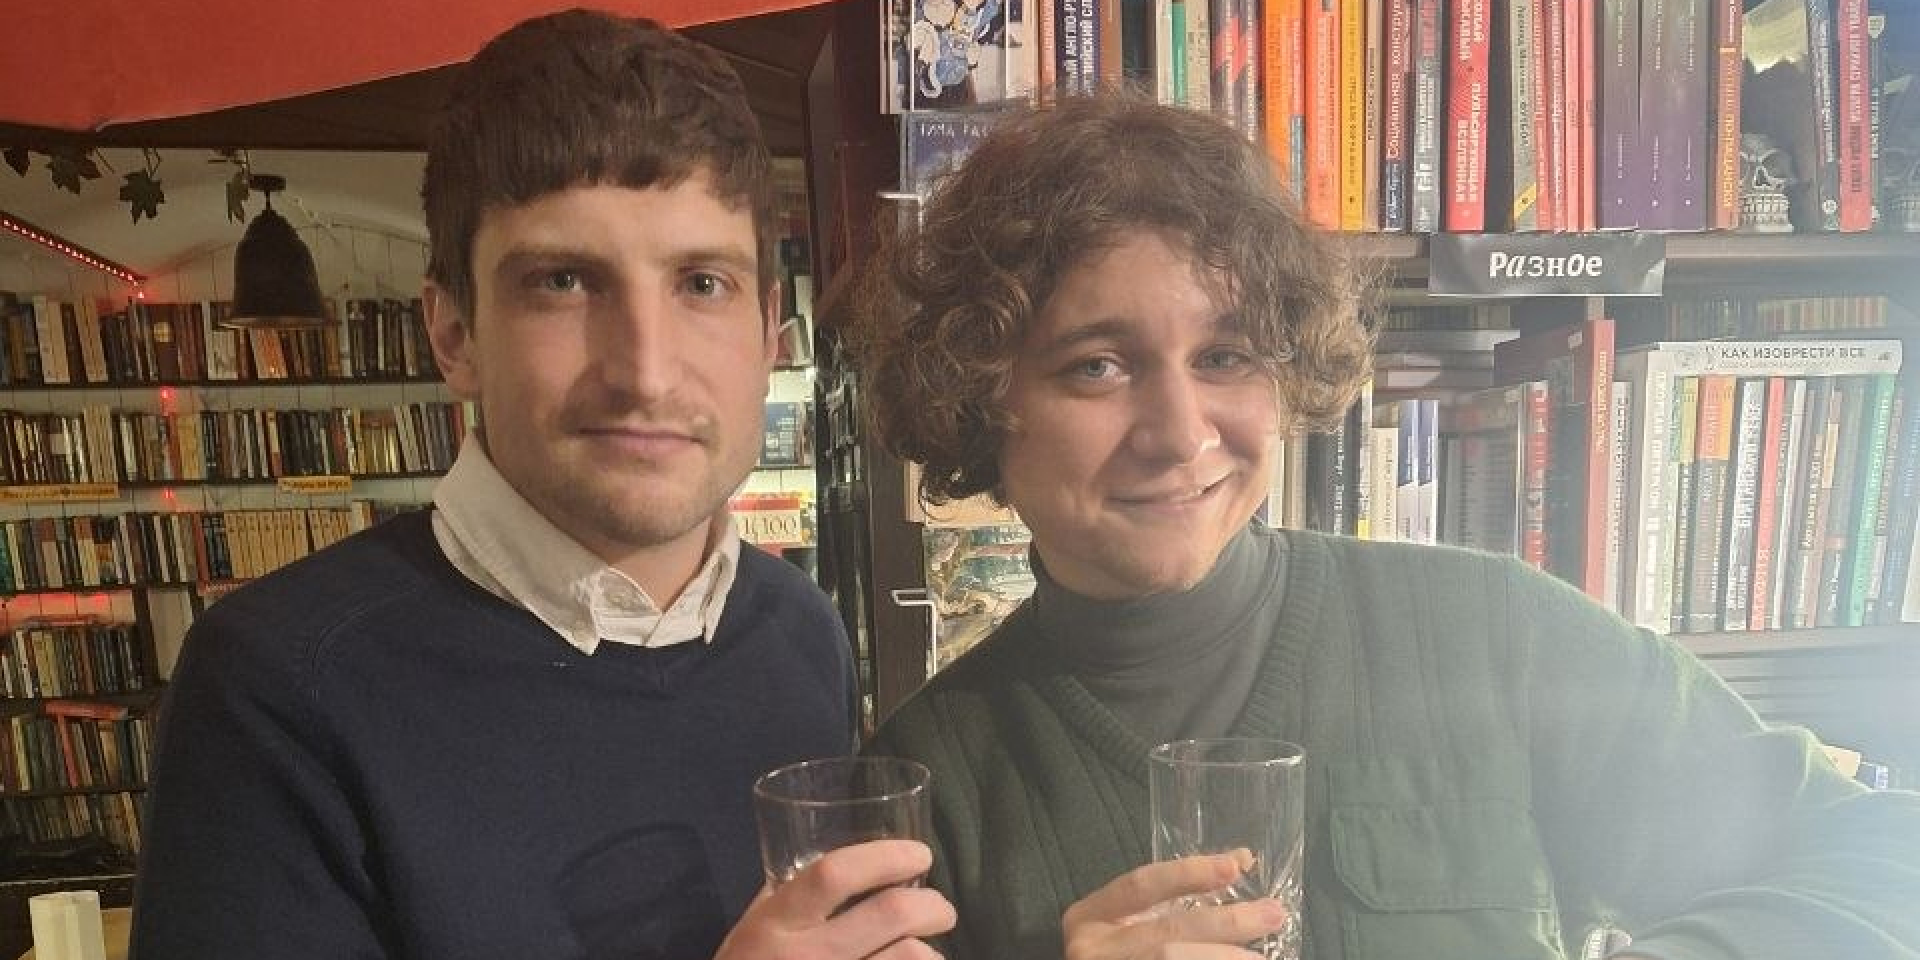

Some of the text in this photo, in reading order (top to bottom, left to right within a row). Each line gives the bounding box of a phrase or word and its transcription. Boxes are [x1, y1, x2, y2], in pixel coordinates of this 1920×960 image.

[1387, 73, 1402, 161] Социальная
[1468, 83, 1482, 202] ПУЛЬСИРУЮЩАЯ
[1456, 119, 1470, 203] ВСЕЛЕННАЯ
[1489, 251, 1603, 278] Разное
[1721, 346, 1750, 359] КАК
[1753, 346, 1835, 359] ИЗОБРЕСТИ
